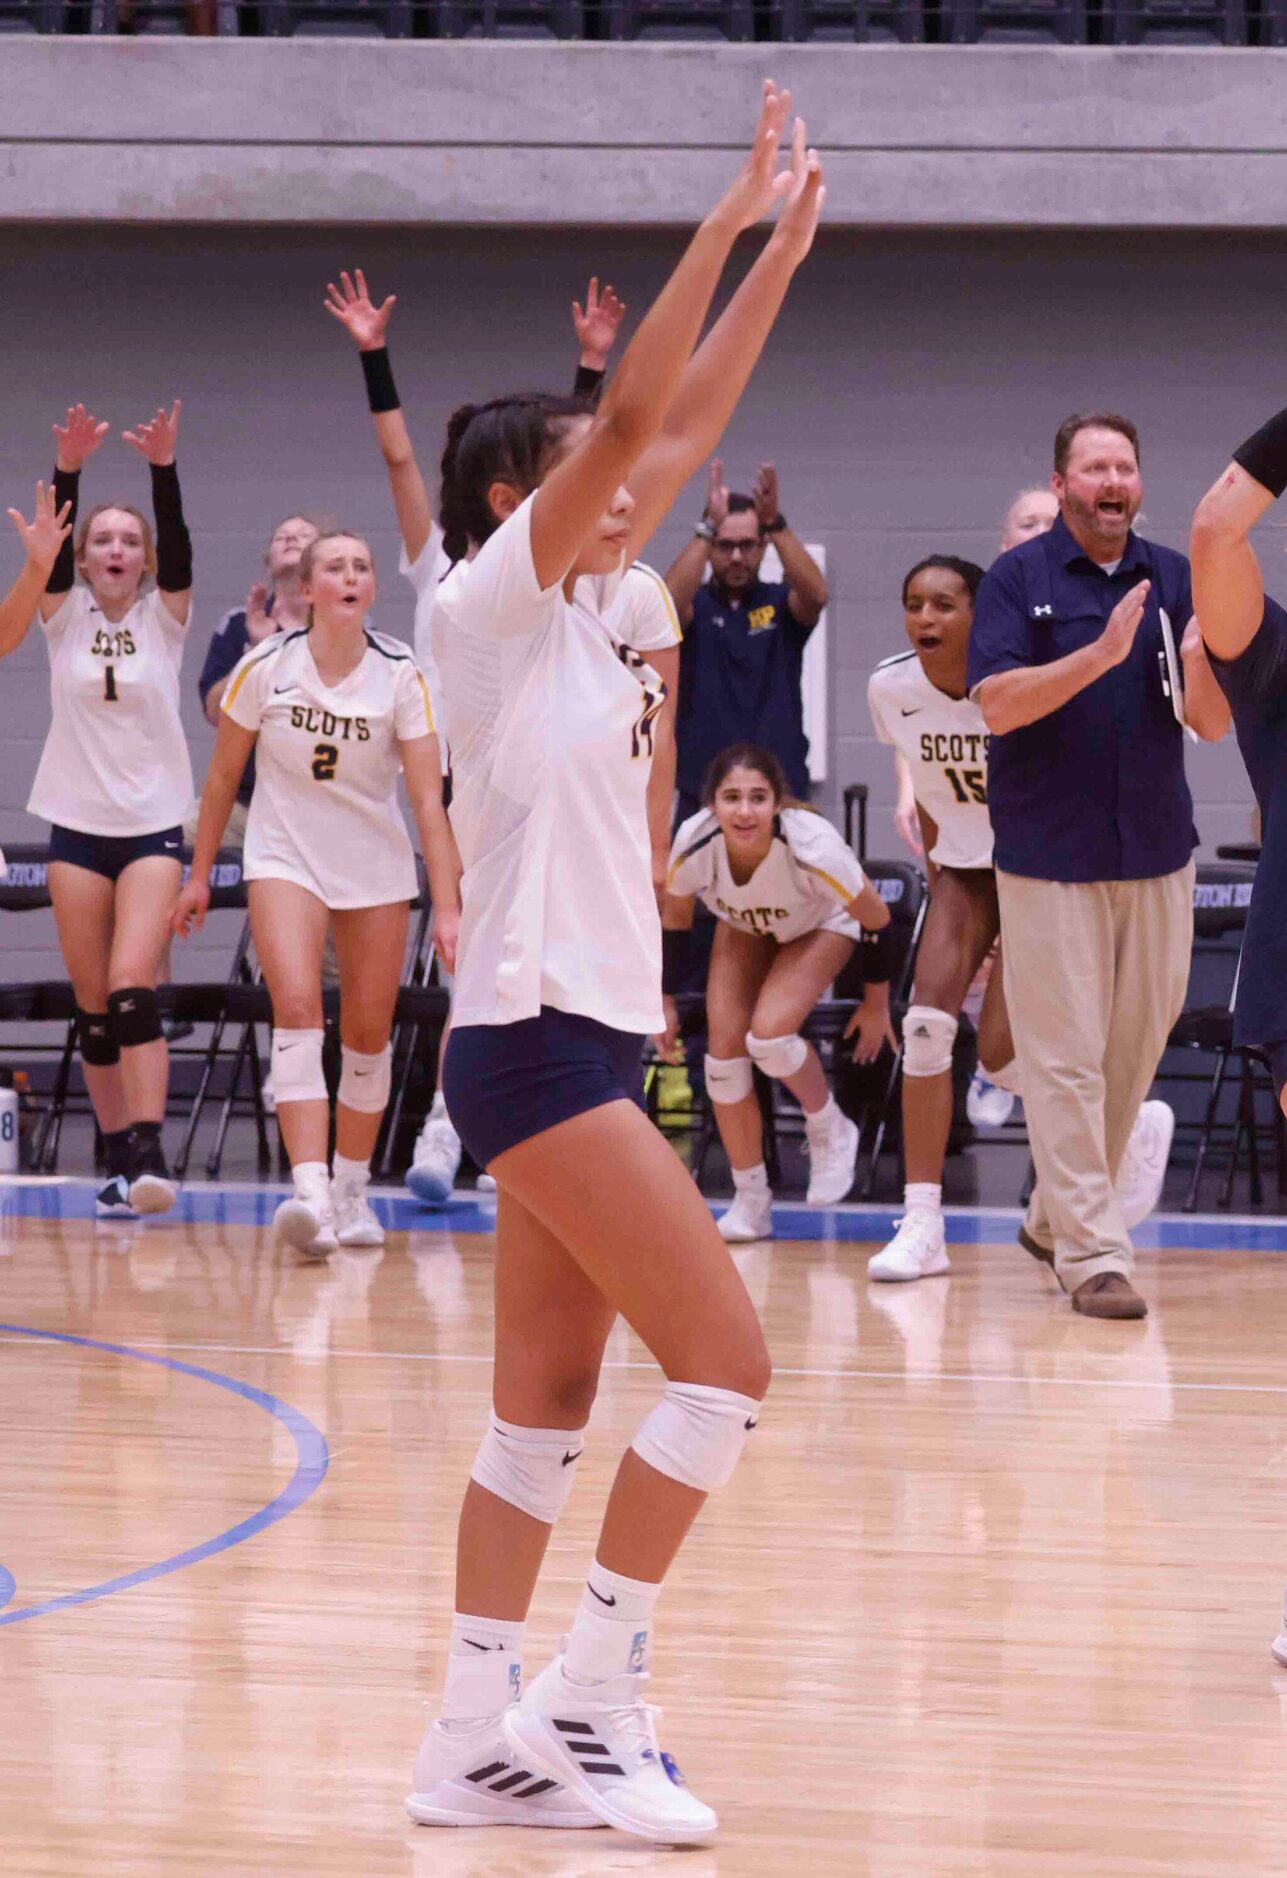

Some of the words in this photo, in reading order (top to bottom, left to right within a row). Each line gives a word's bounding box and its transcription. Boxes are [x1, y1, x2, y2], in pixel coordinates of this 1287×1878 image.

[103, 665, 118, 701] 1
[291, 705, 370, 741] SCOTS
[311, 743, 339, 781] 2
[943, 766, 989, 805] 15
[2, 1111, 13, 1141] 8
